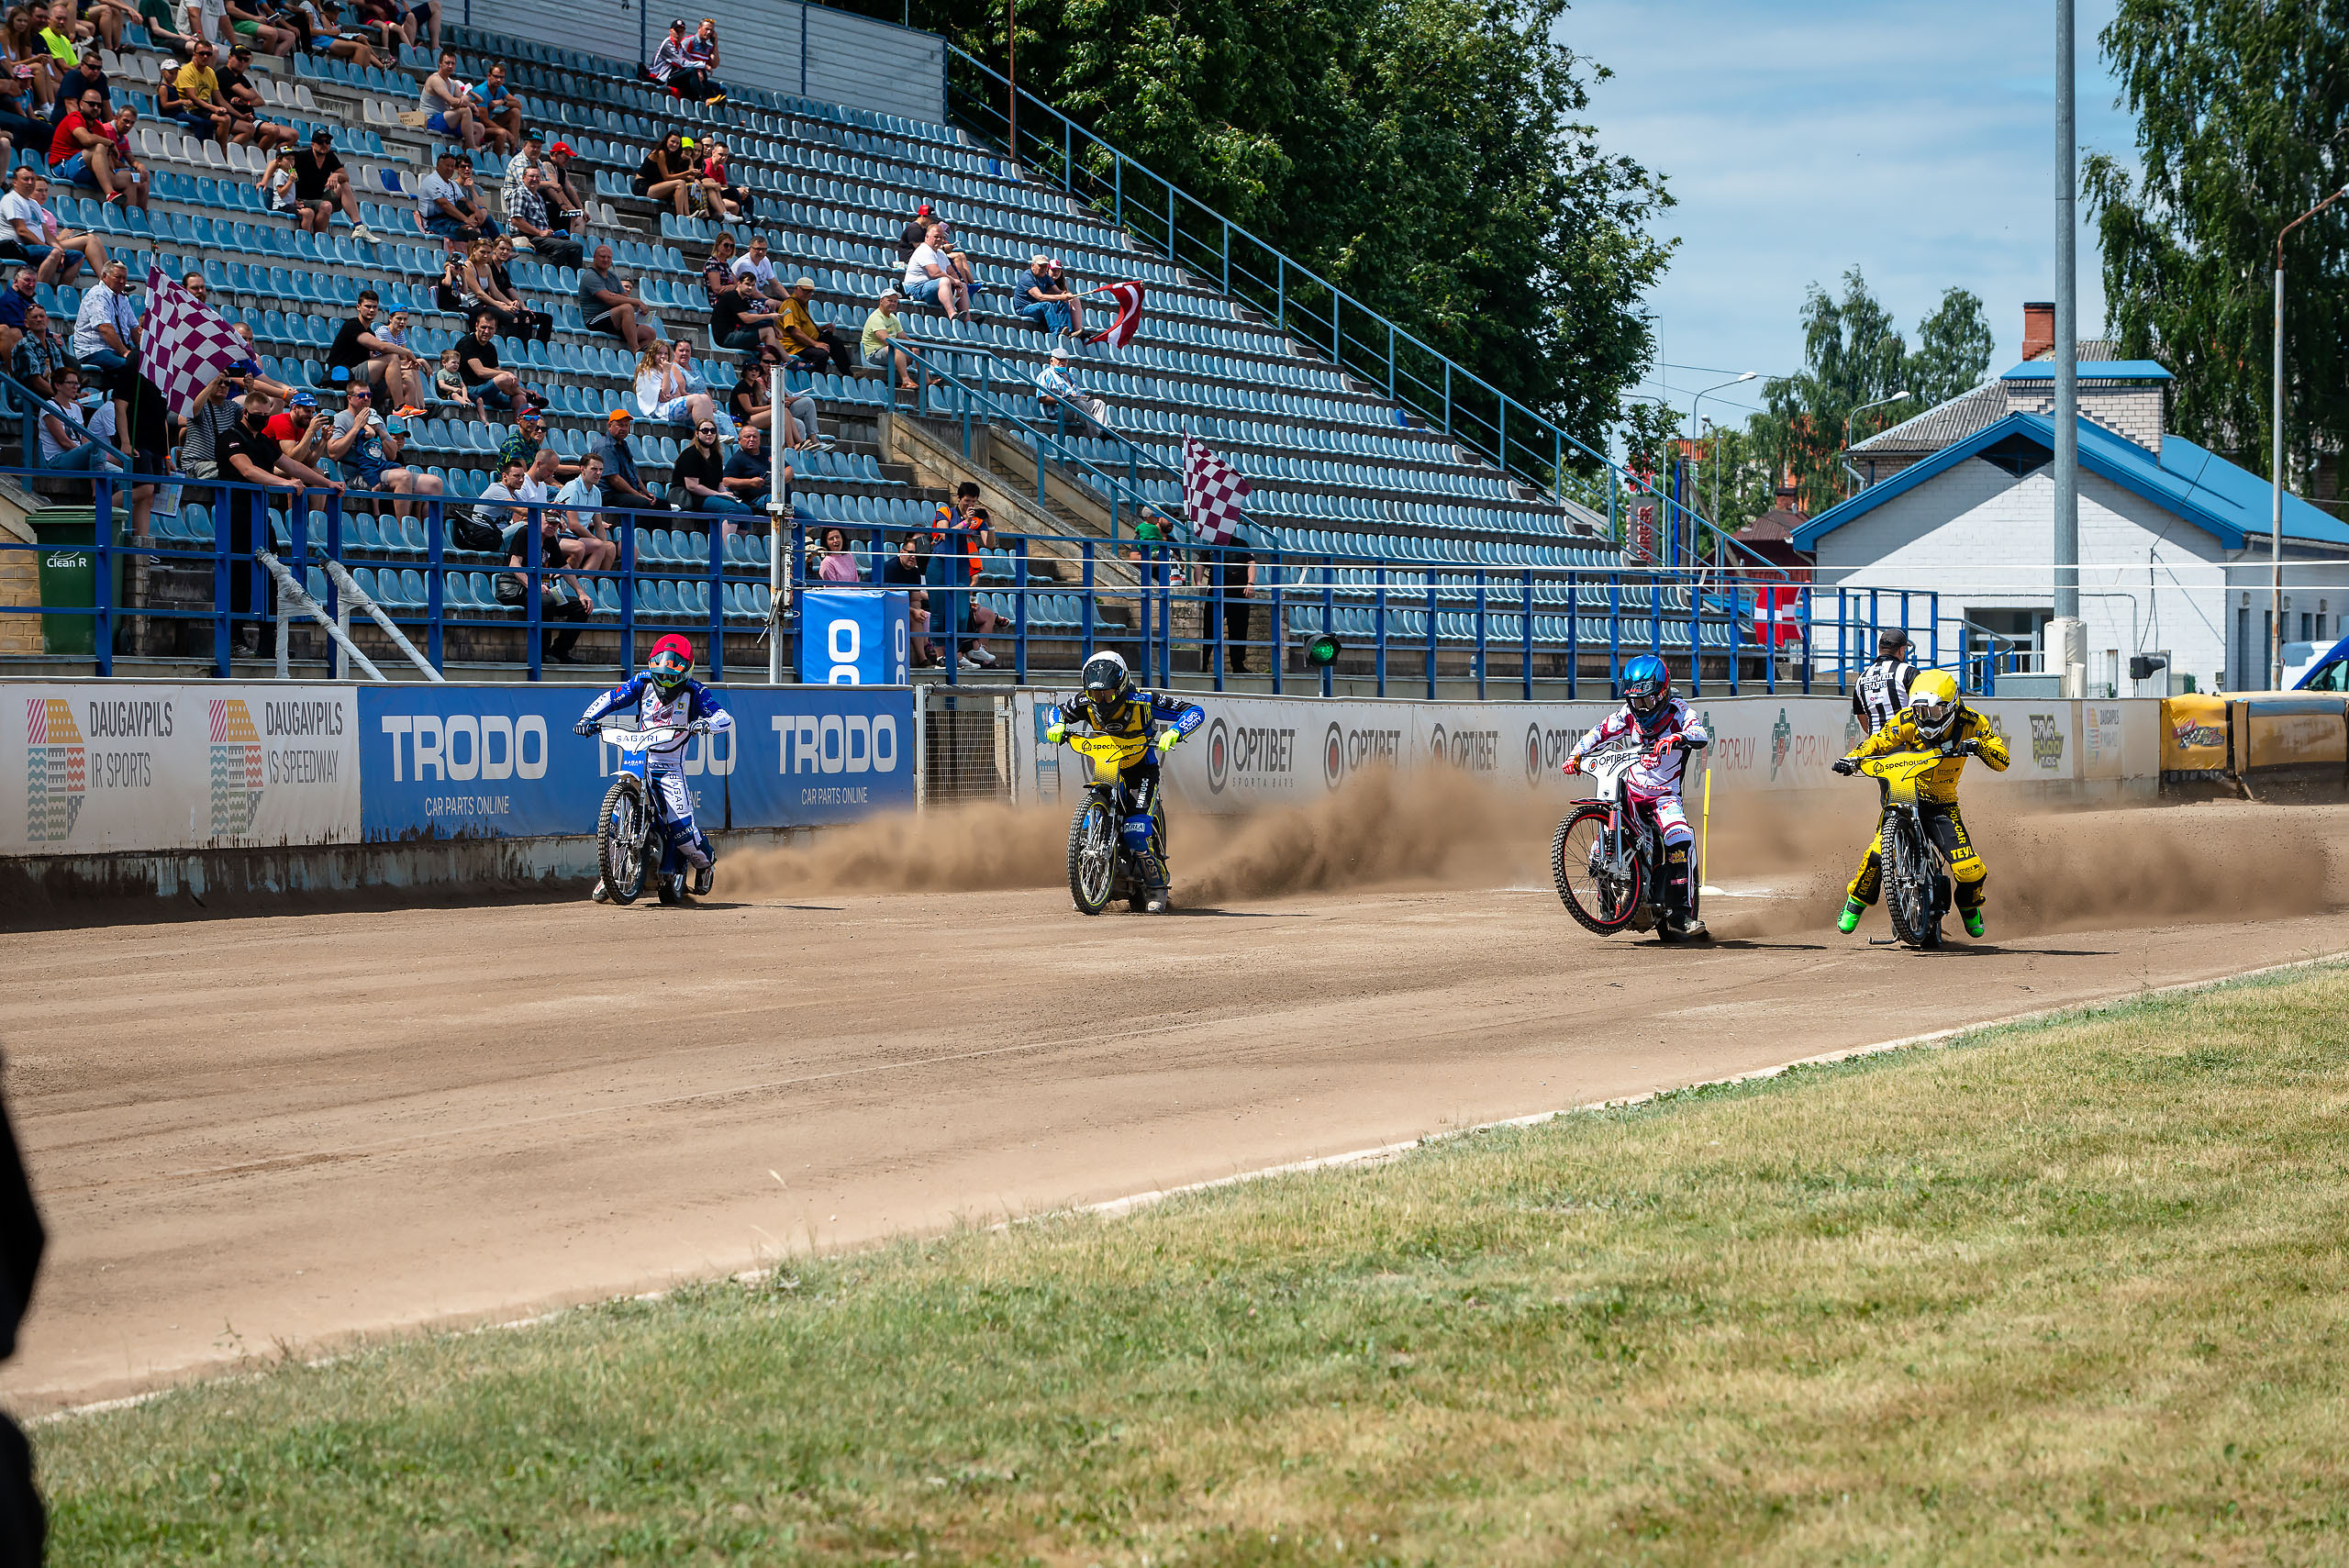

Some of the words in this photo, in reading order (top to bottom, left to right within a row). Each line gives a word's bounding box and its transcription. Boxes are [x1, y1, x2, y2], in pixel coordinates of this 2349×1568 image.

[47, 558, 75, 568] Clean
[79, 558, 87, 567] R
[90, 701, 173, 738] DAUGAVPILS
[265, 701, 343, 736] DAUGAVPILS
[381, 715, 549, 782] TRODO
[616, 735, 658, 743] SAGARI
[772, 714, 897, 774] TRODO
[1233, 727, 1296, 773] OPTIBET
[1348, 729, 1401, 772] OPTIBET
[1451, 730, 1498, 772] OPTIBET
[1719, 737, 1756, 772] PCR.LV
[92, 752, 103, 788] IR
[106, 752, 150, 788] SPORTS
[267, 750, 279, 784] IS
[283, 750, 340, 784] SPEEDWAY
[1598, 752, 1632, 765] OPTIBET
[1885, 758, 1929, 770] spechouse
[669, 773, 685, 815] SAGARI
[801, 788, 817, 806] CAR
[818, 787, 841, 805] PARTS
[842, 786, 868, 805] ONLINE
[1232, 778, 1267, 788] SPORTA
[425, 797, 444, 817] CAR
[445, 796, 474, 816] PARTS
[476, 795, 509, 816] ONLINE
